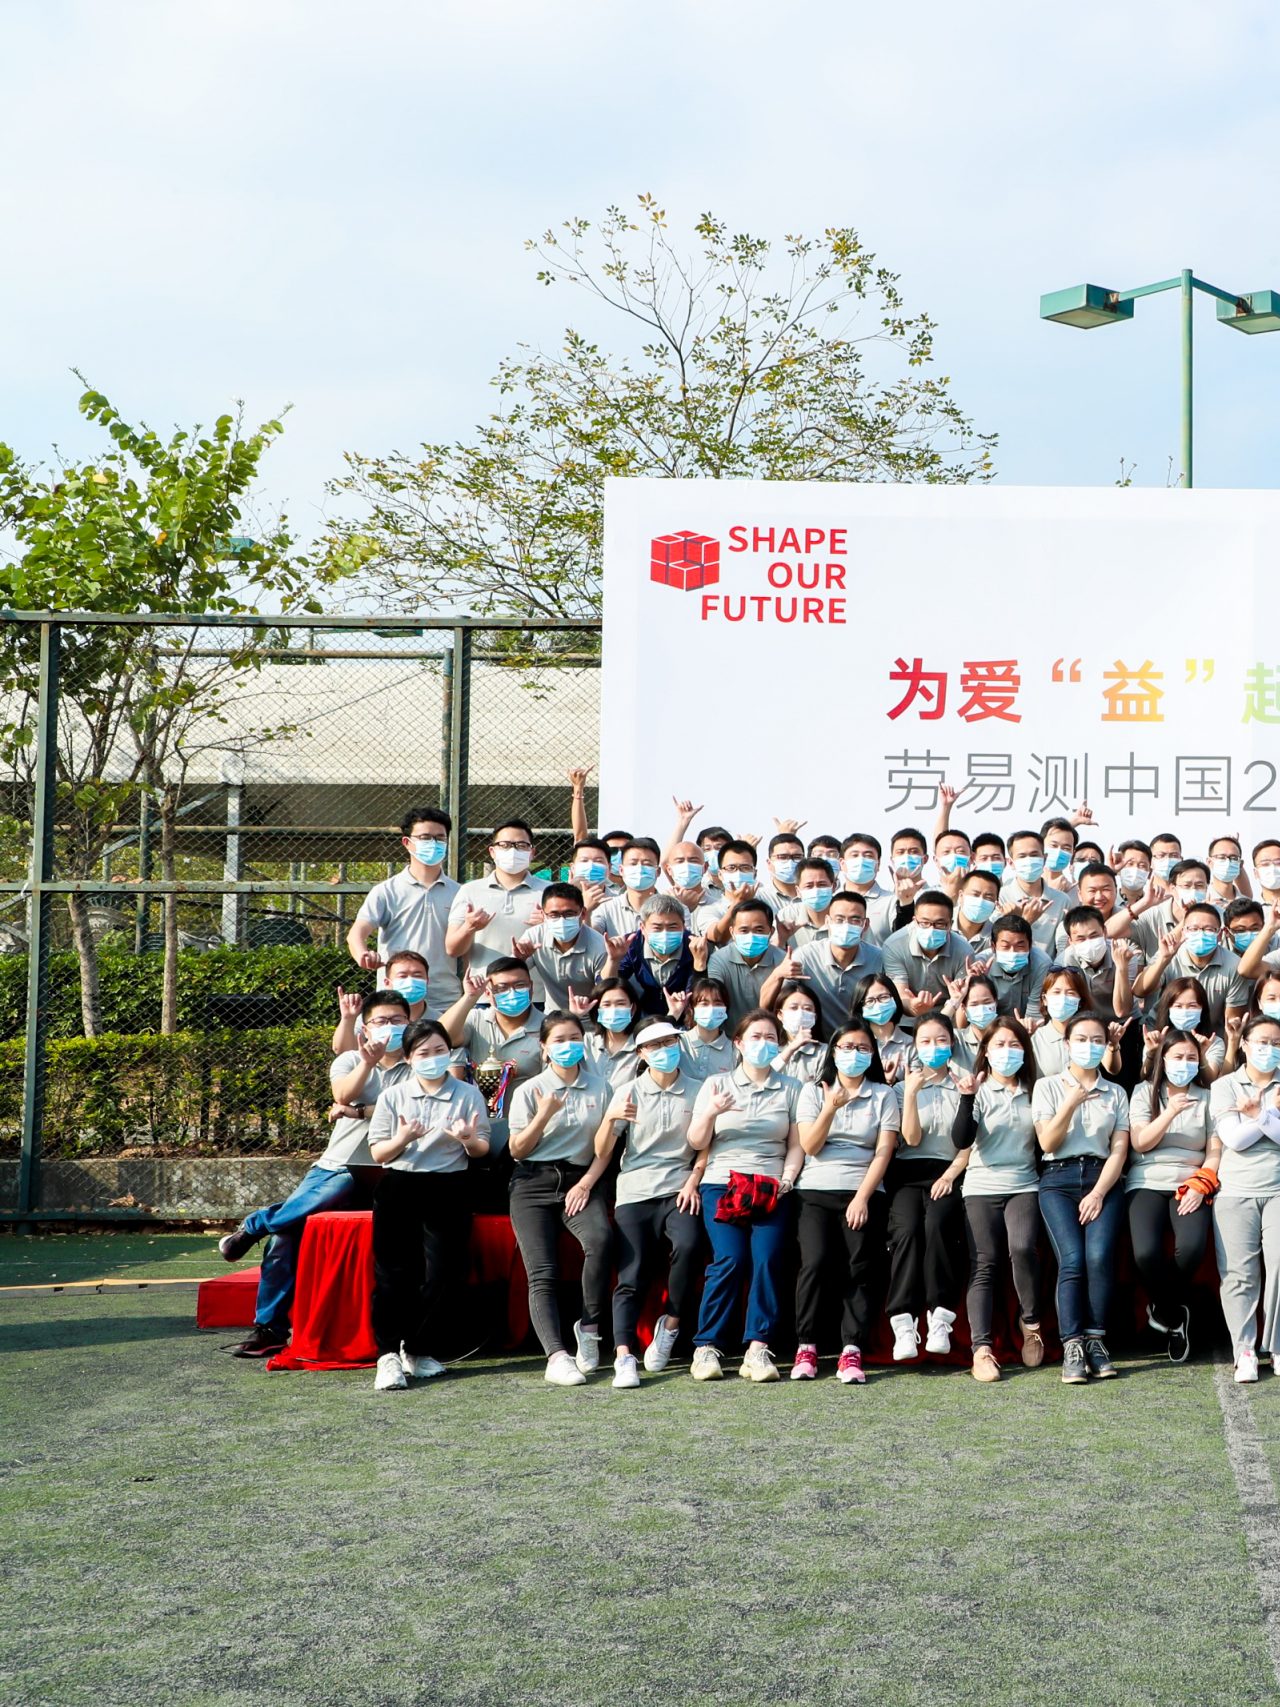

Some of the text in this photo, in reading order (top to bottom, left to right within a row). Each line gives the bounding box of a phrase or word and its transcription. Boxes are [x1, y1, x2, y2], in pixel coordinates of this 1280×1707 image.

[727, 525, 848, 556] SHAPE
[767, 561, 847, 590] OUR
[701, 594, 847, 625] FUTURE
